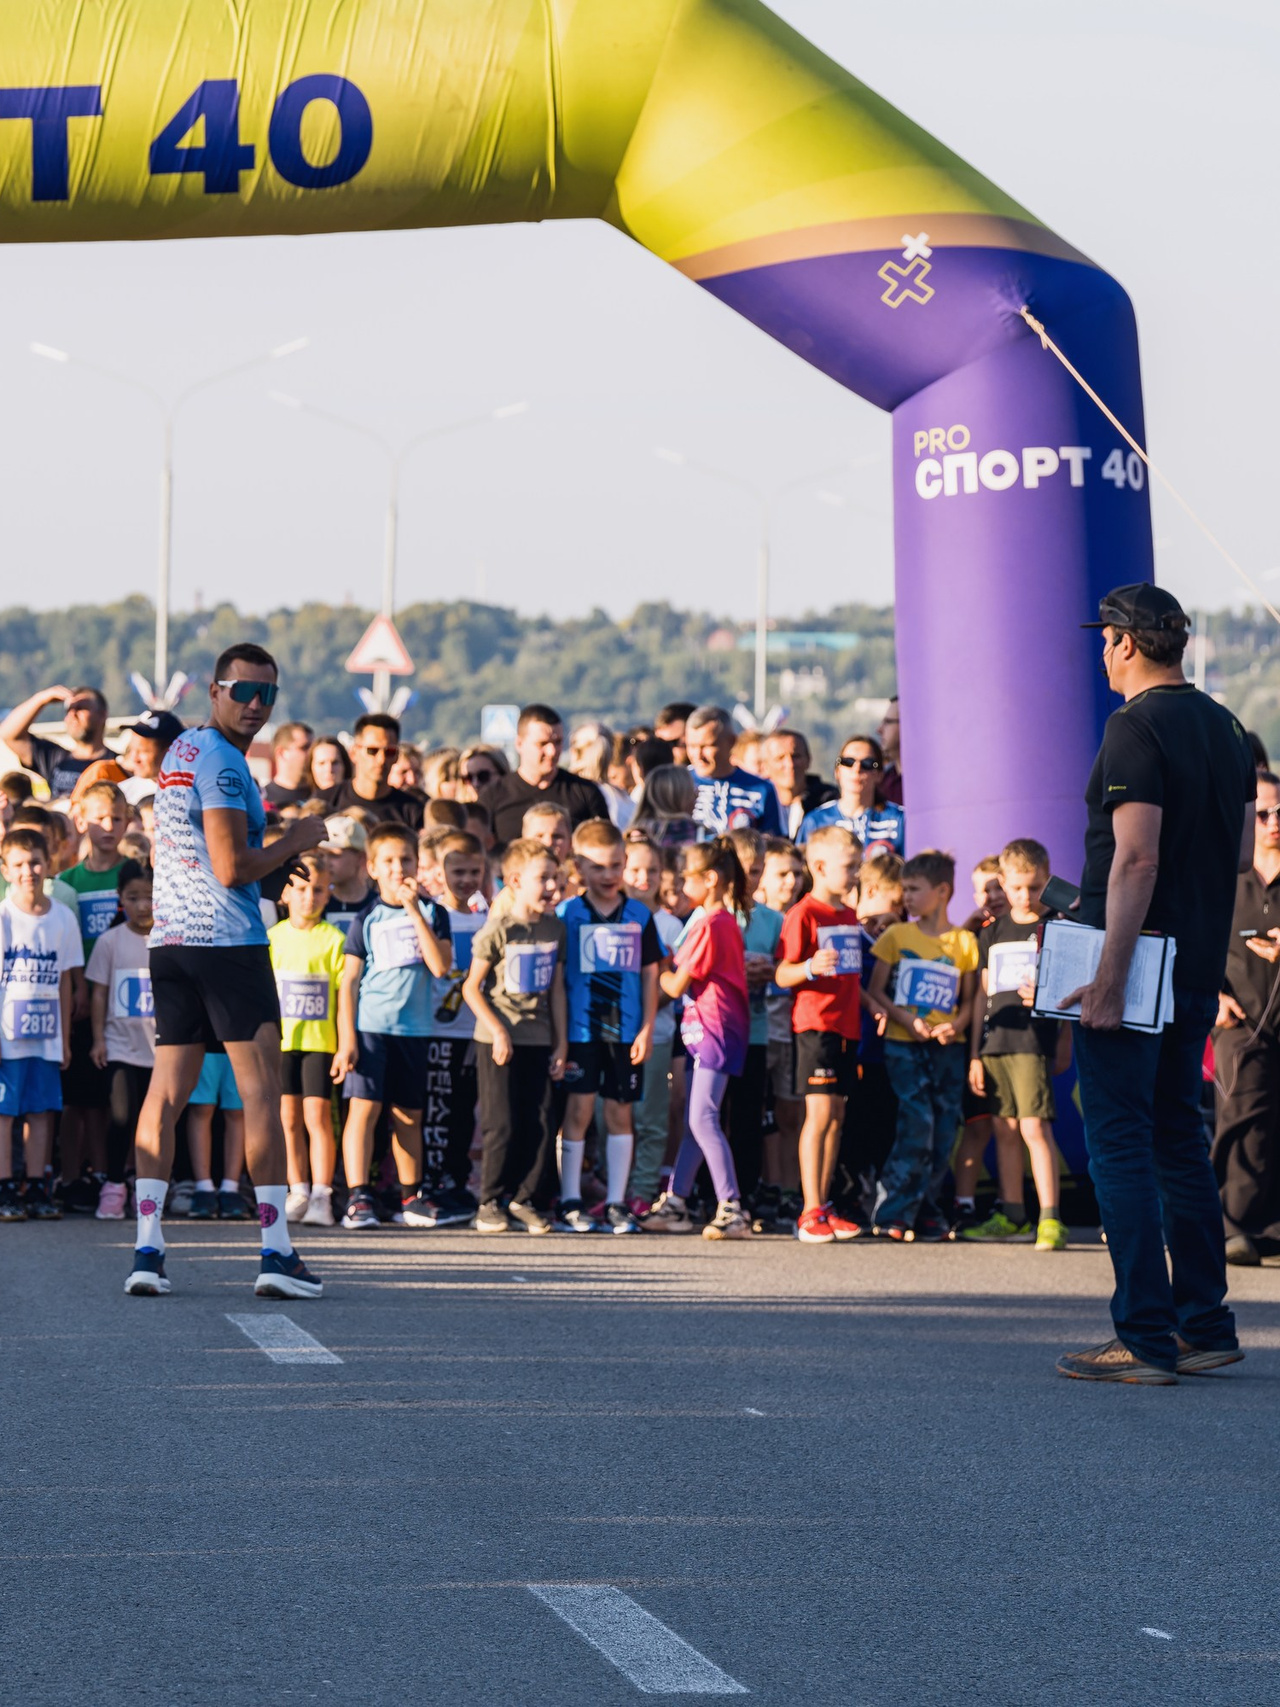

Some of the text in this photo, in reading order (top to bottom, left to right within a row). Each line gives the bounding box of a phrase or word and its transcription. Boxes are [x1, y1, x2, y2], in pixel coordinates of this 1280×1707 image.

[149, 73, 373, 194] 40
[914, 424, 971, 458] PRO
[915, 446, 1144, 499] СПОРТ 40
[605, 946, 635, 967] 717
[285, 994, 325, 1016] 3758
[914, 981, 953, 1009] 2372
[21, 1013, 55, 1034] 2812
